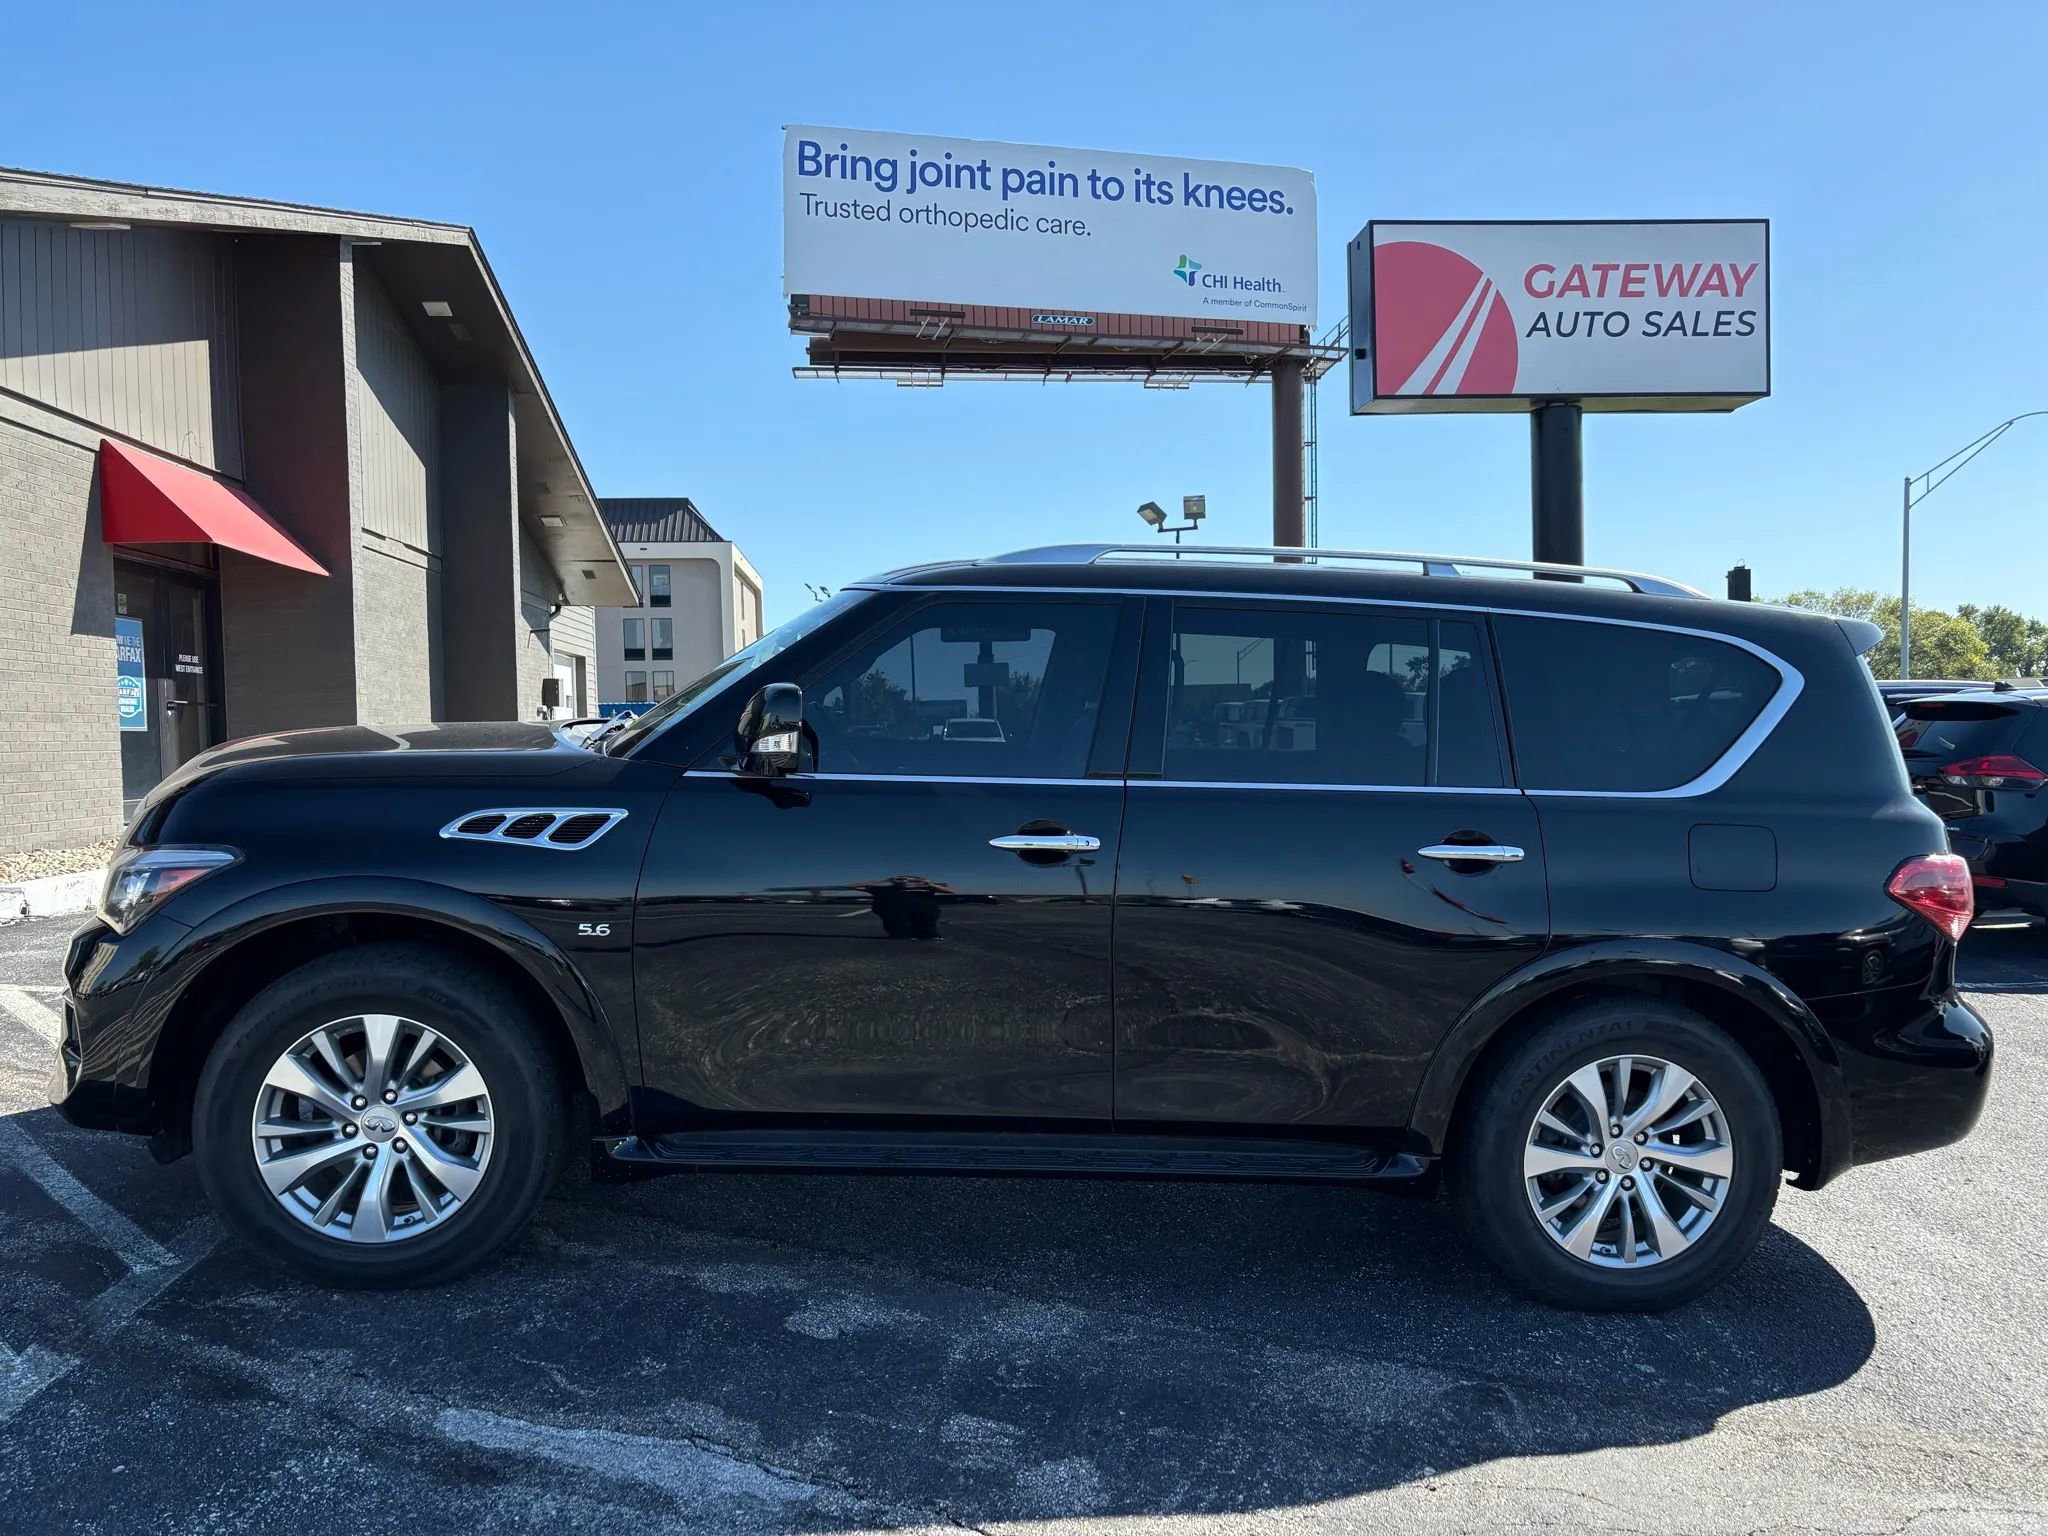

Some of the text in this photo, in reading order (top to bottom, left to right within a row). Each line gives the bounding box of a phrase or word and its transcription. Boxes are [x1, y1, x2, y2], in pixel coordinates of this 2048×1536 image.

[798, 140, 1295, 215] Bring joint pain to its knees.
[799, 191, 1092, 237] Trusted orthopedic care.
[1202, 274, 1282, 293] CHI Health
[1524, 263, 1759, 298] GATEWAY
[1202, 296, 1308, 313] A member of CommonSpirit
[1037, 315, 1089, 325] LAMAR
[1525, 310, 1757, 338] AUTO SALES
